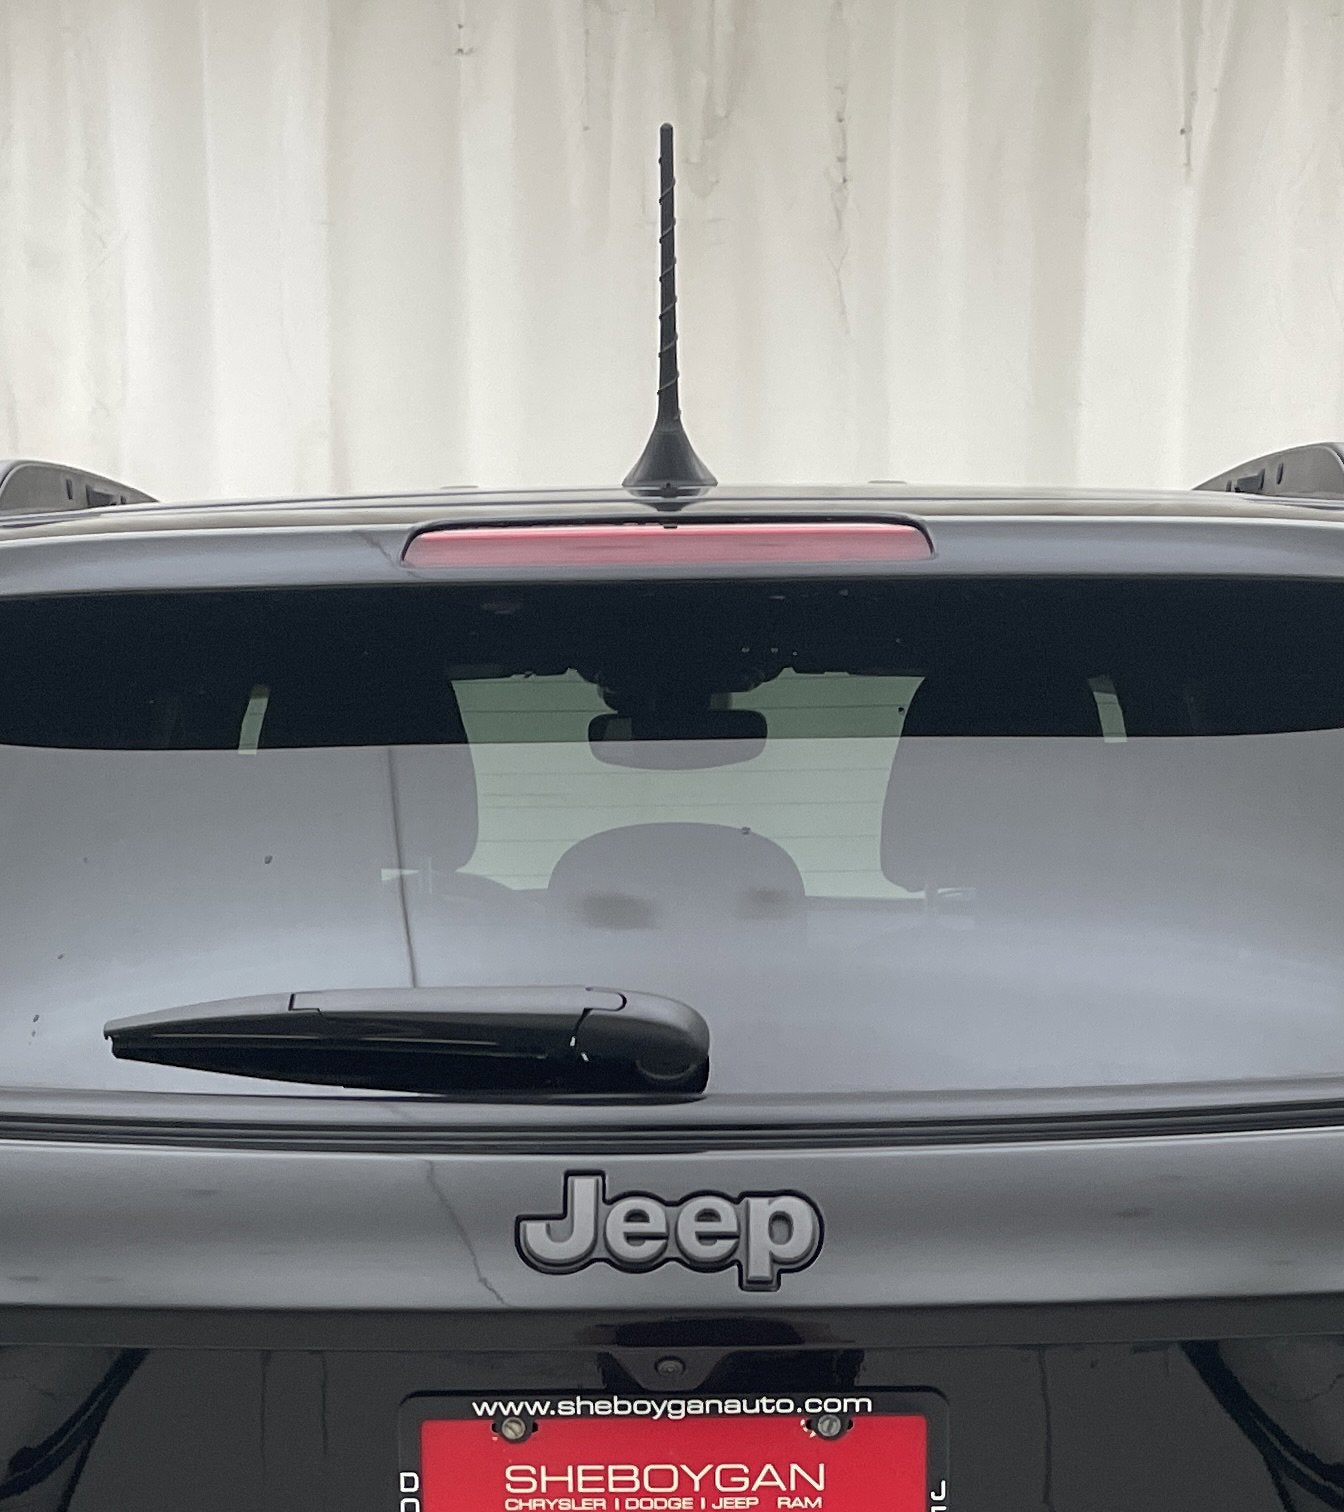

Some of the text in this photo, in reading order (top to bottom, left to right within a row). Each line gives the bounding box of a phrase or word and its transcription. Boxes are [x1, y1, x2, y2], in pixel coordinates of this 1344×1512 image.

[517, 1172, 820, 1286] Jeep
[471, 1394, 873, 1419] www.sheboyganauto.com
[504, 1463, 826, 1494] SHEBOYGAN
[504, 1496, 823, 1511] CHRYSLER DODGE JEEP RAM
